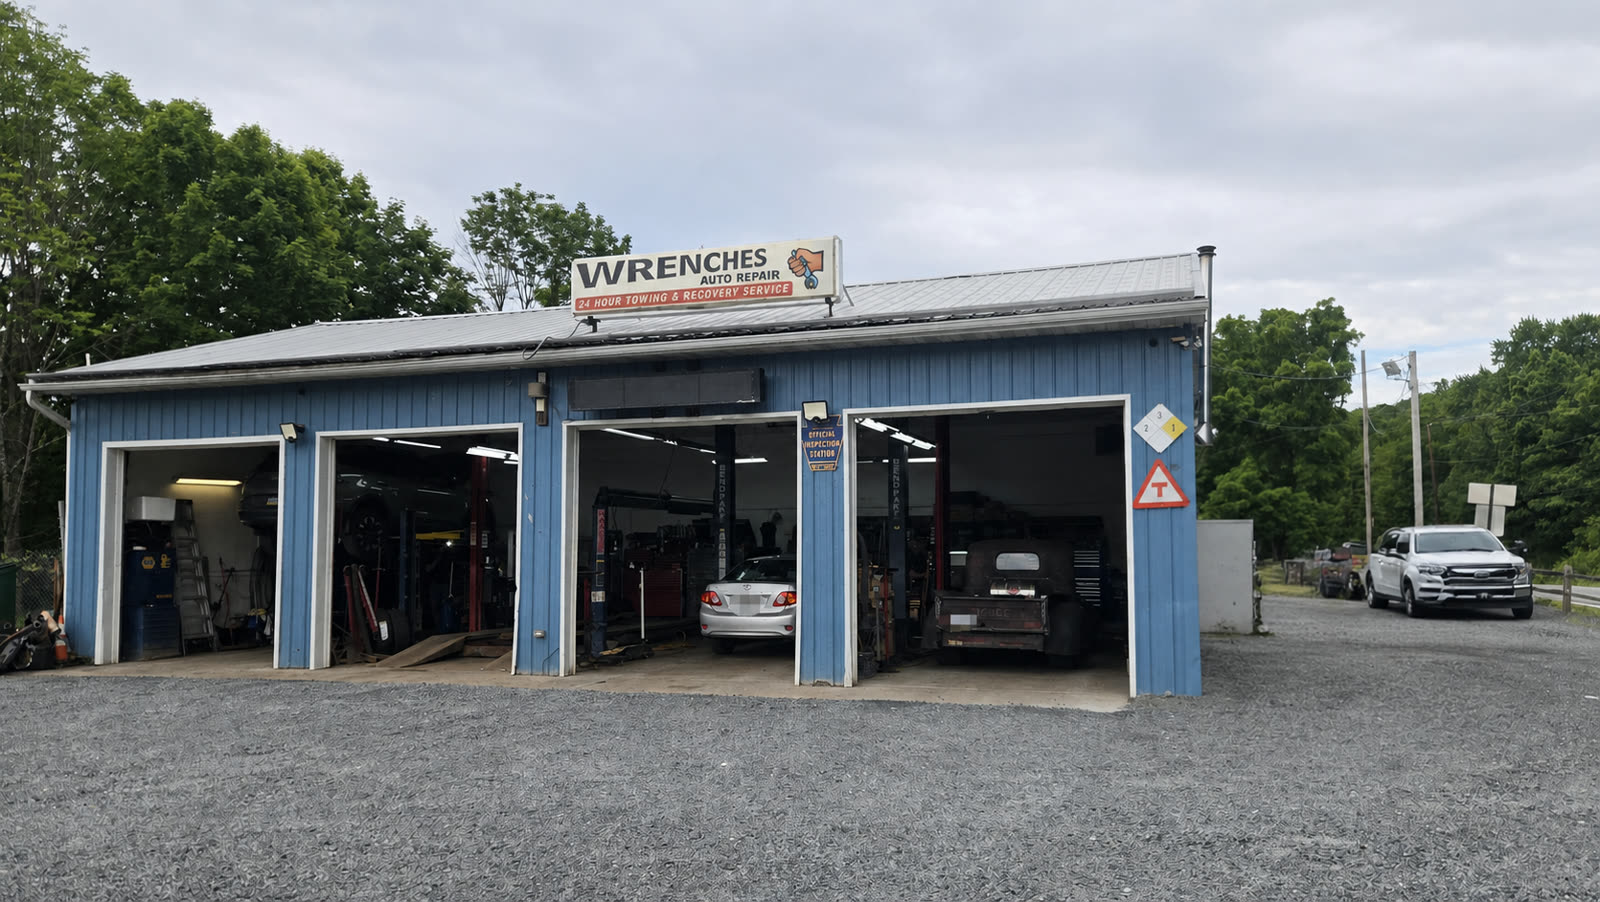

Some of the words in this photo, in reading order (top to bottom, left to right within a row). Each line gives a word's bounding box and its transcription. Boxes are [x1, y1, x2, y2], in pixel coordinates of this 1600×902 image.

[576, 248, 767, 289] WRENCHES
[700, 273, 732, 286] AUTO
[736, 270, 780, 283] REPAIR
[578, 300, 590, 309] 24
[594, 297, 622, 307] HOUR
[626, 292, 668, 305] TOWING
[671, 291, 679, 301] &
[683, 286, 740, 301] RECOVERY
[743, 283, 790, 297] SERVICE
[1157, 411, 1162, 419] 3
[1144, 424, 1149, 432] 2
[1172, 424, 1176, 432] 1
[808, 430, 835, 439] OFFICIAL
[804, 439, 840, 449] INSPECTION
[809, 450, 835, 458] STATION
[1151, 481, 1168, 498] T
